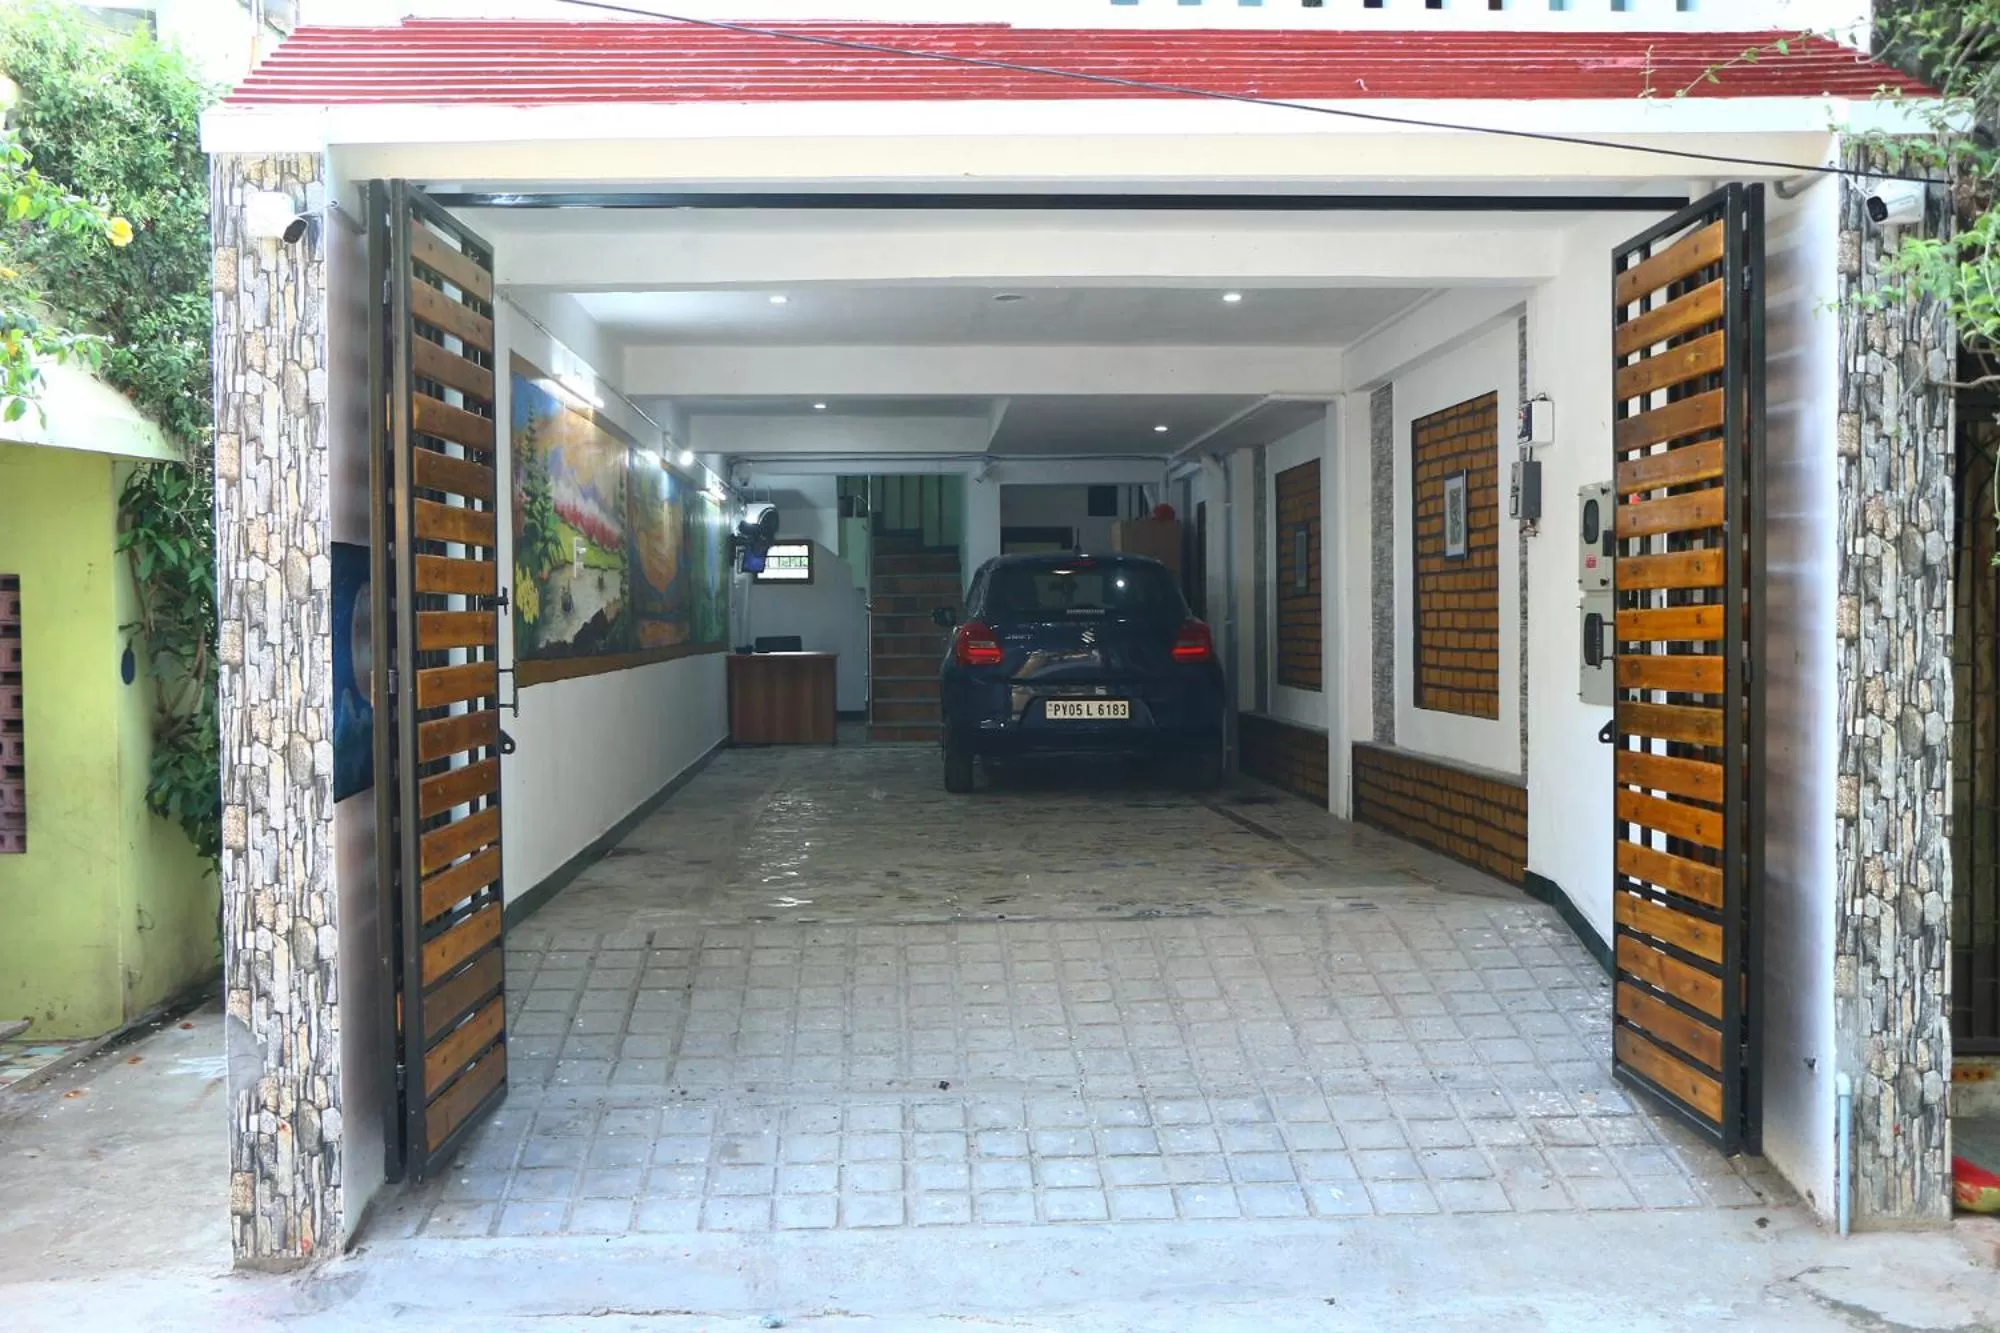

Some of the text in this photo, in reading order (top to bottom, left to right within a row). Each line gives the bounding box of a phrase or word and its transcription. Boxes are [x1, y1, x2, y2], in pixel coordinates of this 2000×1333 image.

[1054, 703, 1127, 716] PY05 L 6183
